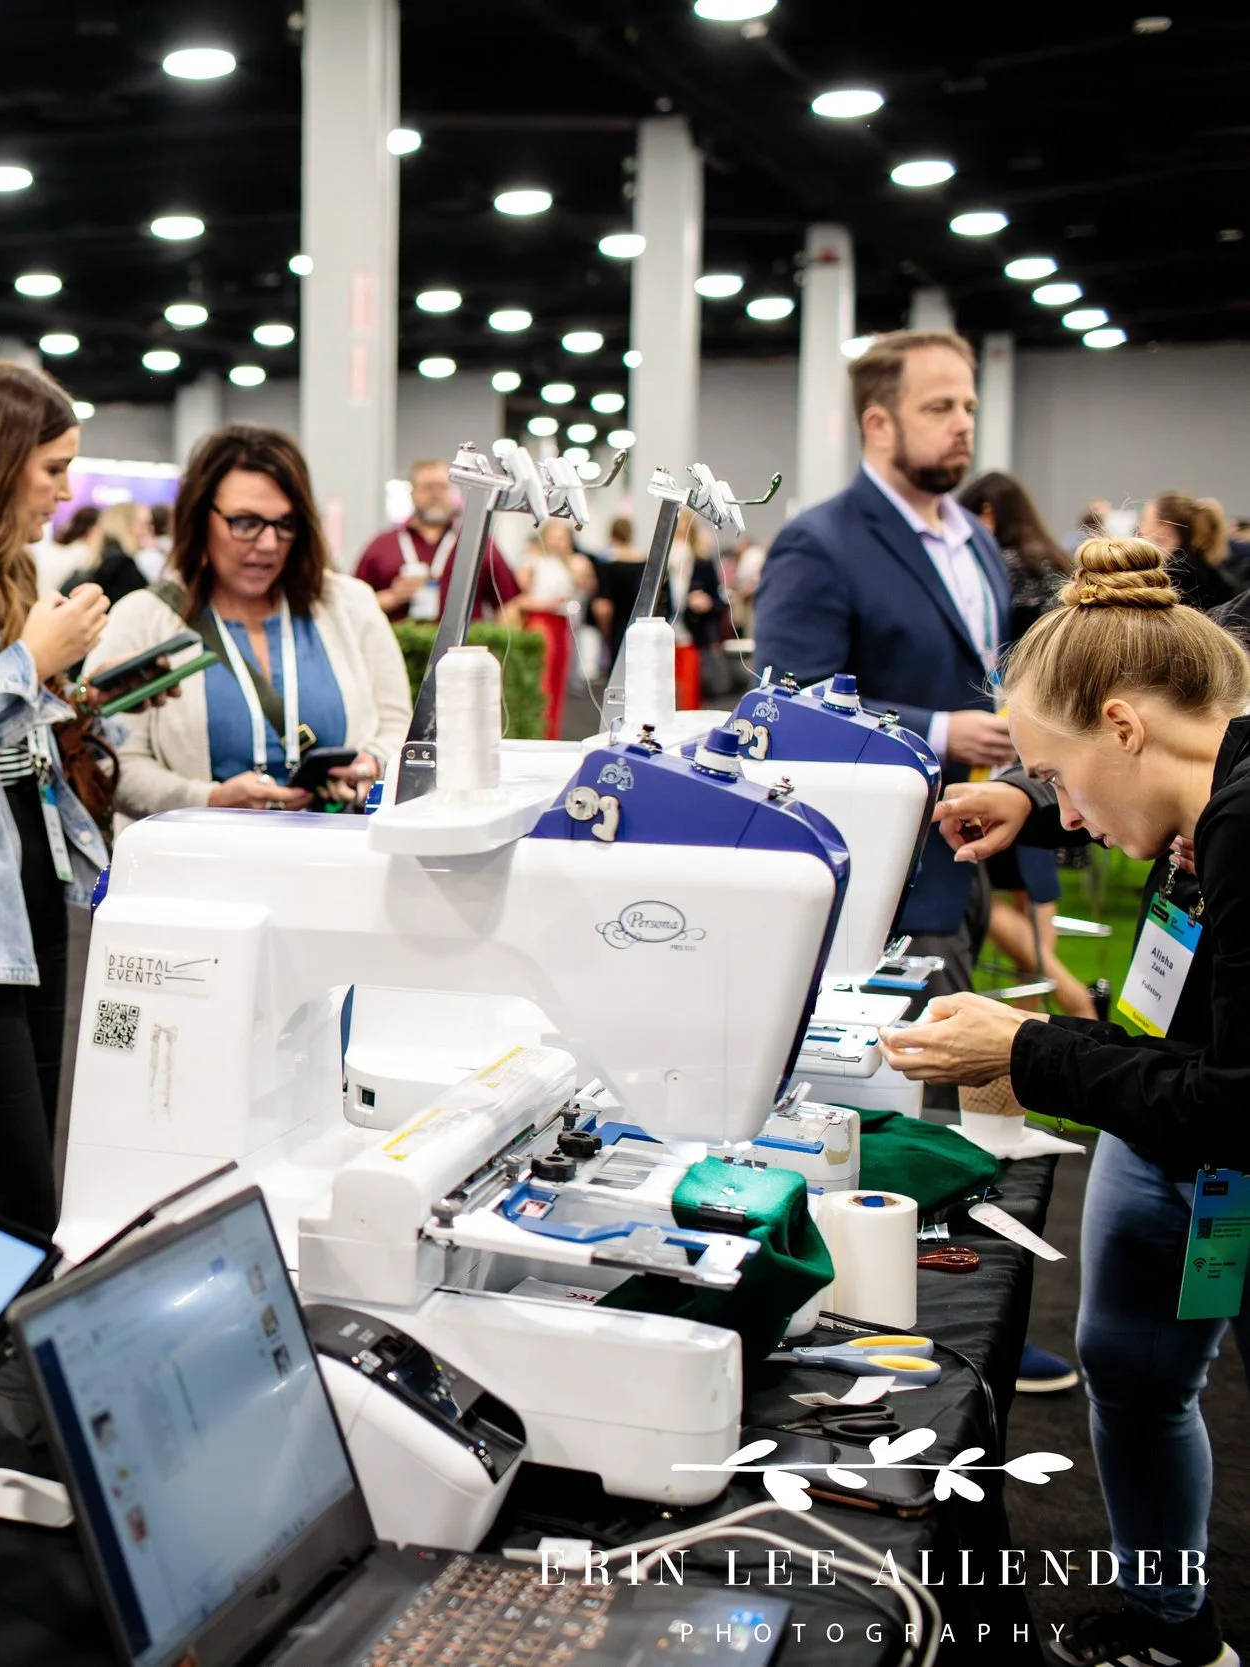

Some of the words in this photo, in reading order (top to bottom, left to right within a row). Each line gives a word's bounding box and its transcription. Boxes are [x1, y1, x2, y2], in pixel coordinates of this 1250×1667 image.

[626, 911, 678, 930] Persona
[109, 954, 172, 973] DIGITAL
[1151, 947, 1173, 970] Alisha
[108, 968, 162, 985] EVENTS
